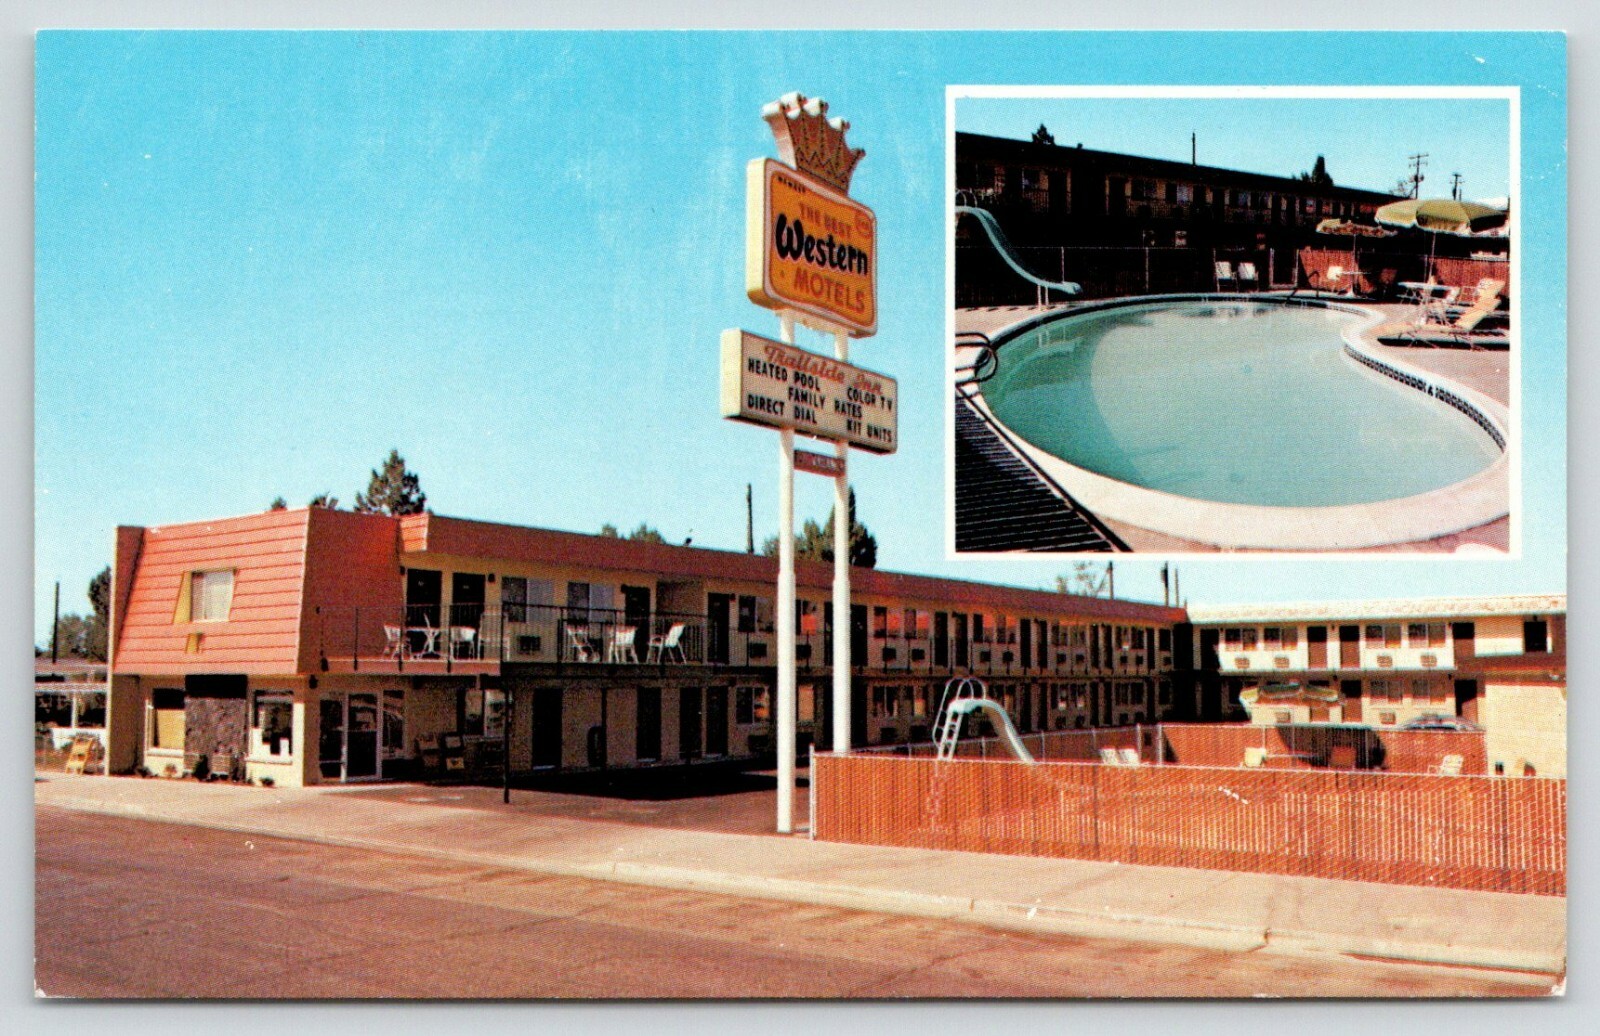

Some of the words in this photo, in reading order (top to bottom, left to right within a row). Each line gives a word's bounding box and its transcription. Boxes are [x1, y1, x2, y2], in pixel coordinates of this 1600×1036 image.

[800, 202, 821, 226] THE
[824, 213, 851, 238] BEST
[775, 213, 868, 275] Western
[793, 266, 865, 314] MOTELS
[748, 358, 788, 382] HEATED
[794, 371, 821, 392] POOL
[847, 387, 876, 405] COLOR
[788, 387, 826, 410] FAMILY
[834, 398, 863, 418] RATES
[747, 394, 785, 416] DIRECT
[794, 406, 818, 424] DIAL
[846, 420, 862, 435] KIT
[867, 425, 892, 443] UNITS
